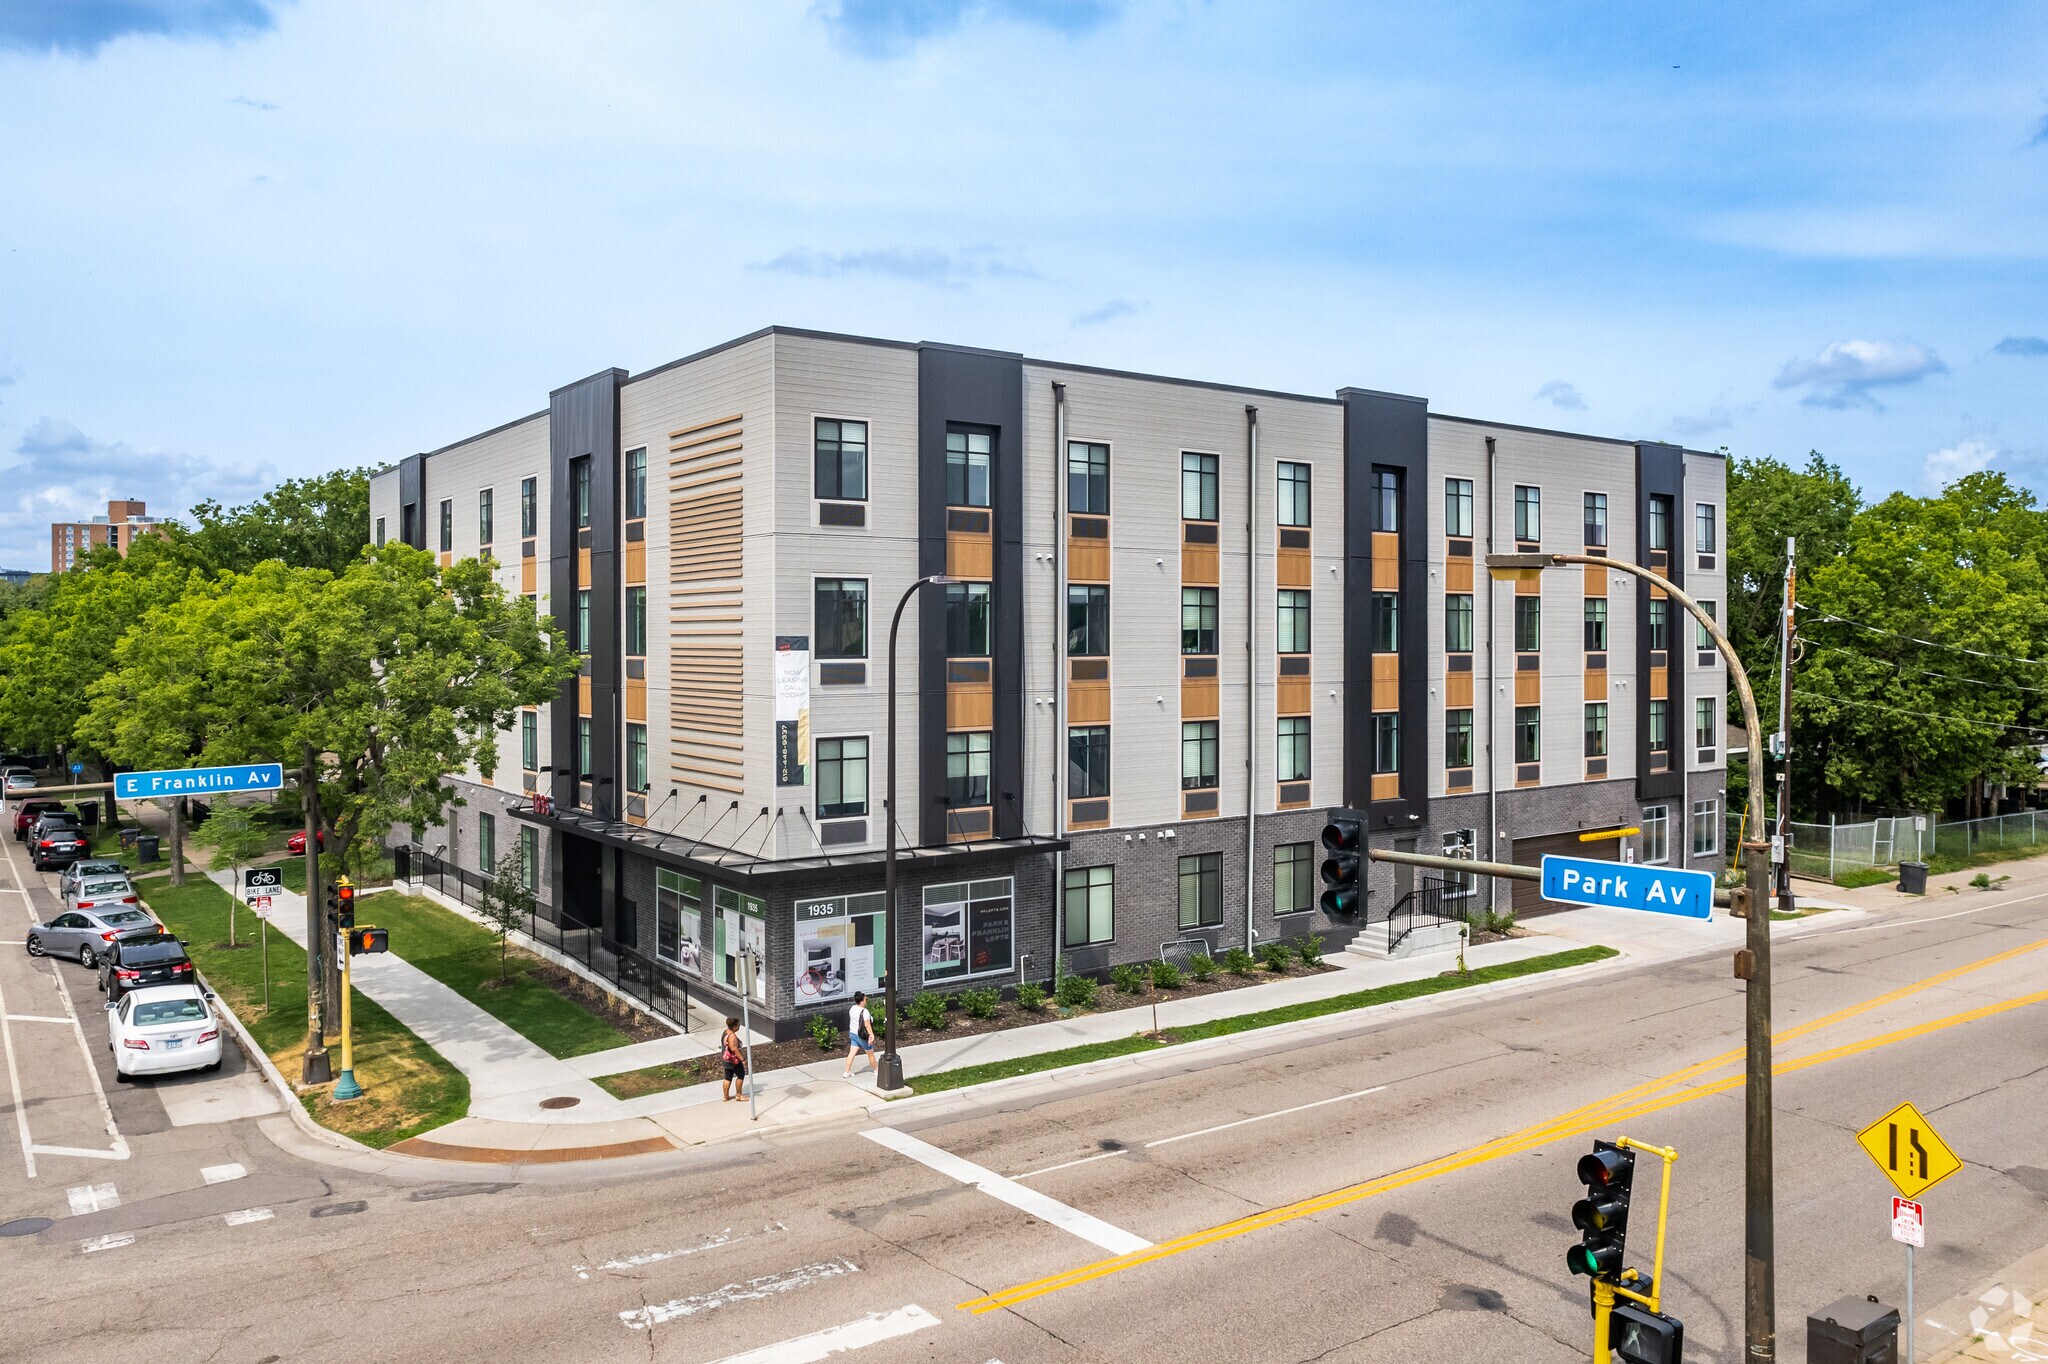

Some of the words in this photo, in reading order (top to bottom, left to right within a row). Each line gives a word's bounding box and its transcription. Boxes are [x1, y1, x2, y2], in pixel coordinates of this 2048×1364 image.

[777, 676, 808, 684] LEASING
[127, 779, 138, 792] E
[152, 774, 233, 790] Franklin
[247, 771, 271, 784] Av
[265, 886, 280, 894] LANE
[1563, 868, 1628, 898] Park
[1646, 879, 1686, 905] Av
[747, 902, 758, 913] 1935
[808, 903, 834, 916] 1935
[983, 920, 1003, 928] PARK
[972, 926, 1010, 937] FRANKLIN
[985, 934, 1009, 942] LOFTS
